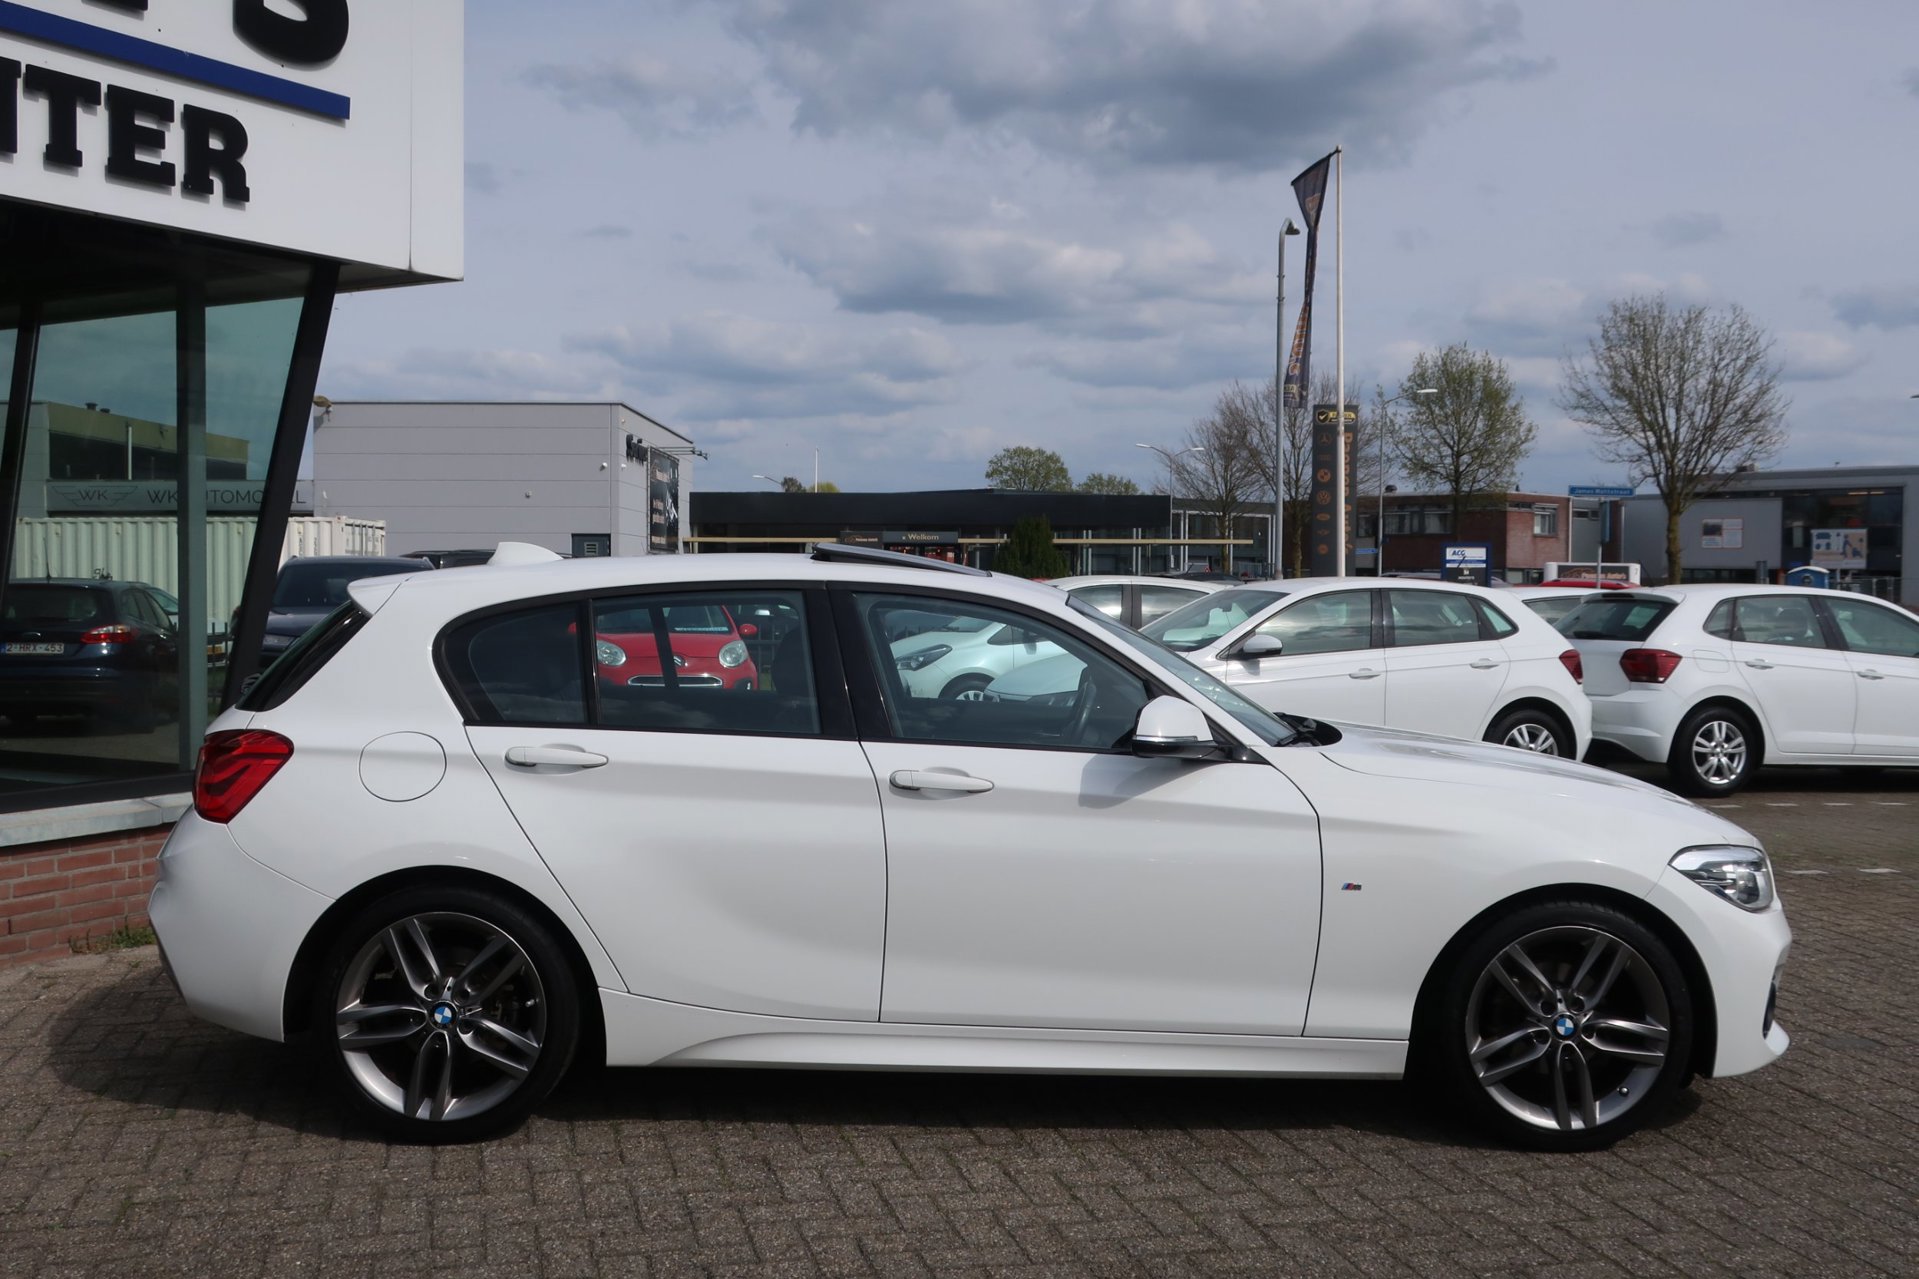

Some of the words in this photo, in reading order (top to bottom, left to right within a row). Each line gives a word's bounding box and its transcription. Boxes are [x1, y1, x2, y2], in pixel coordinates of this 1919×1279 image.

[0, 56, 250, 203] TER
[79, 489, 109, 502] WK
[907, 533, 940, 541] Welkom
